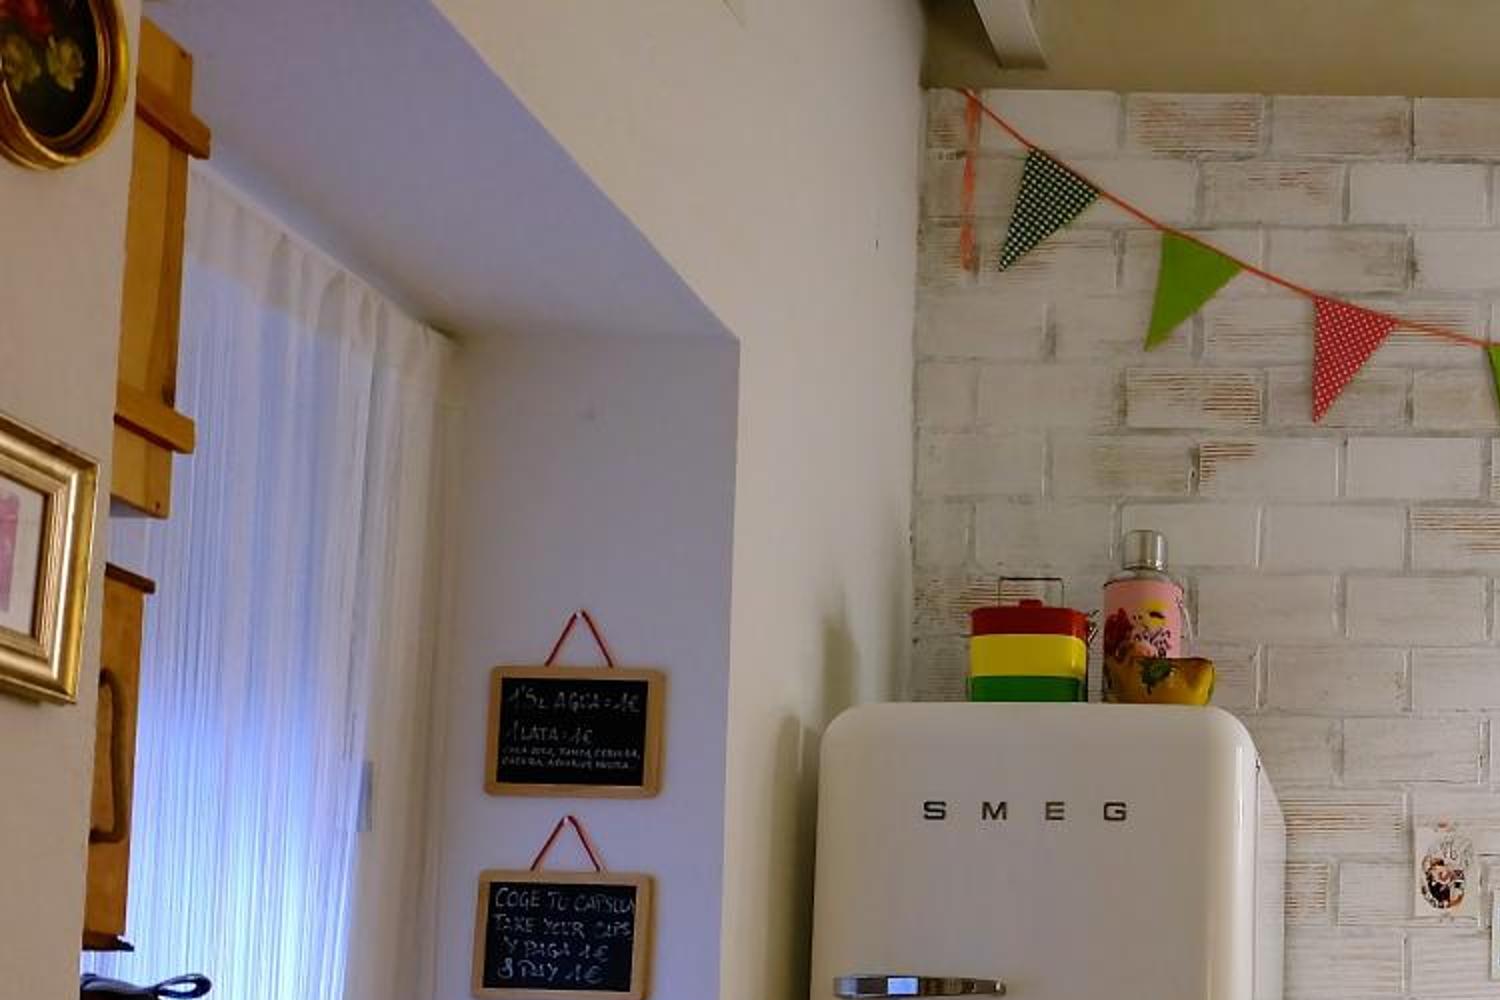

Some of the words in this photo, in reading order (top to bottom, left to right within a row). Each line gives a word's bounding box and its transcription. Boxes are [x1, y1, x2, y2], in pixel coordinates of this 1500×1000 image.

[521, 725, 559, 741] LATA
[923, 801, 1127, 821] SMEG
[495, 887, 541, 910] COGE
[548, 891, 568, 911] TU
[494, 913, 536, 933] TAKE
[543, 917, 585, 939] YOUR
[517, 960, 559, 981] PAY
